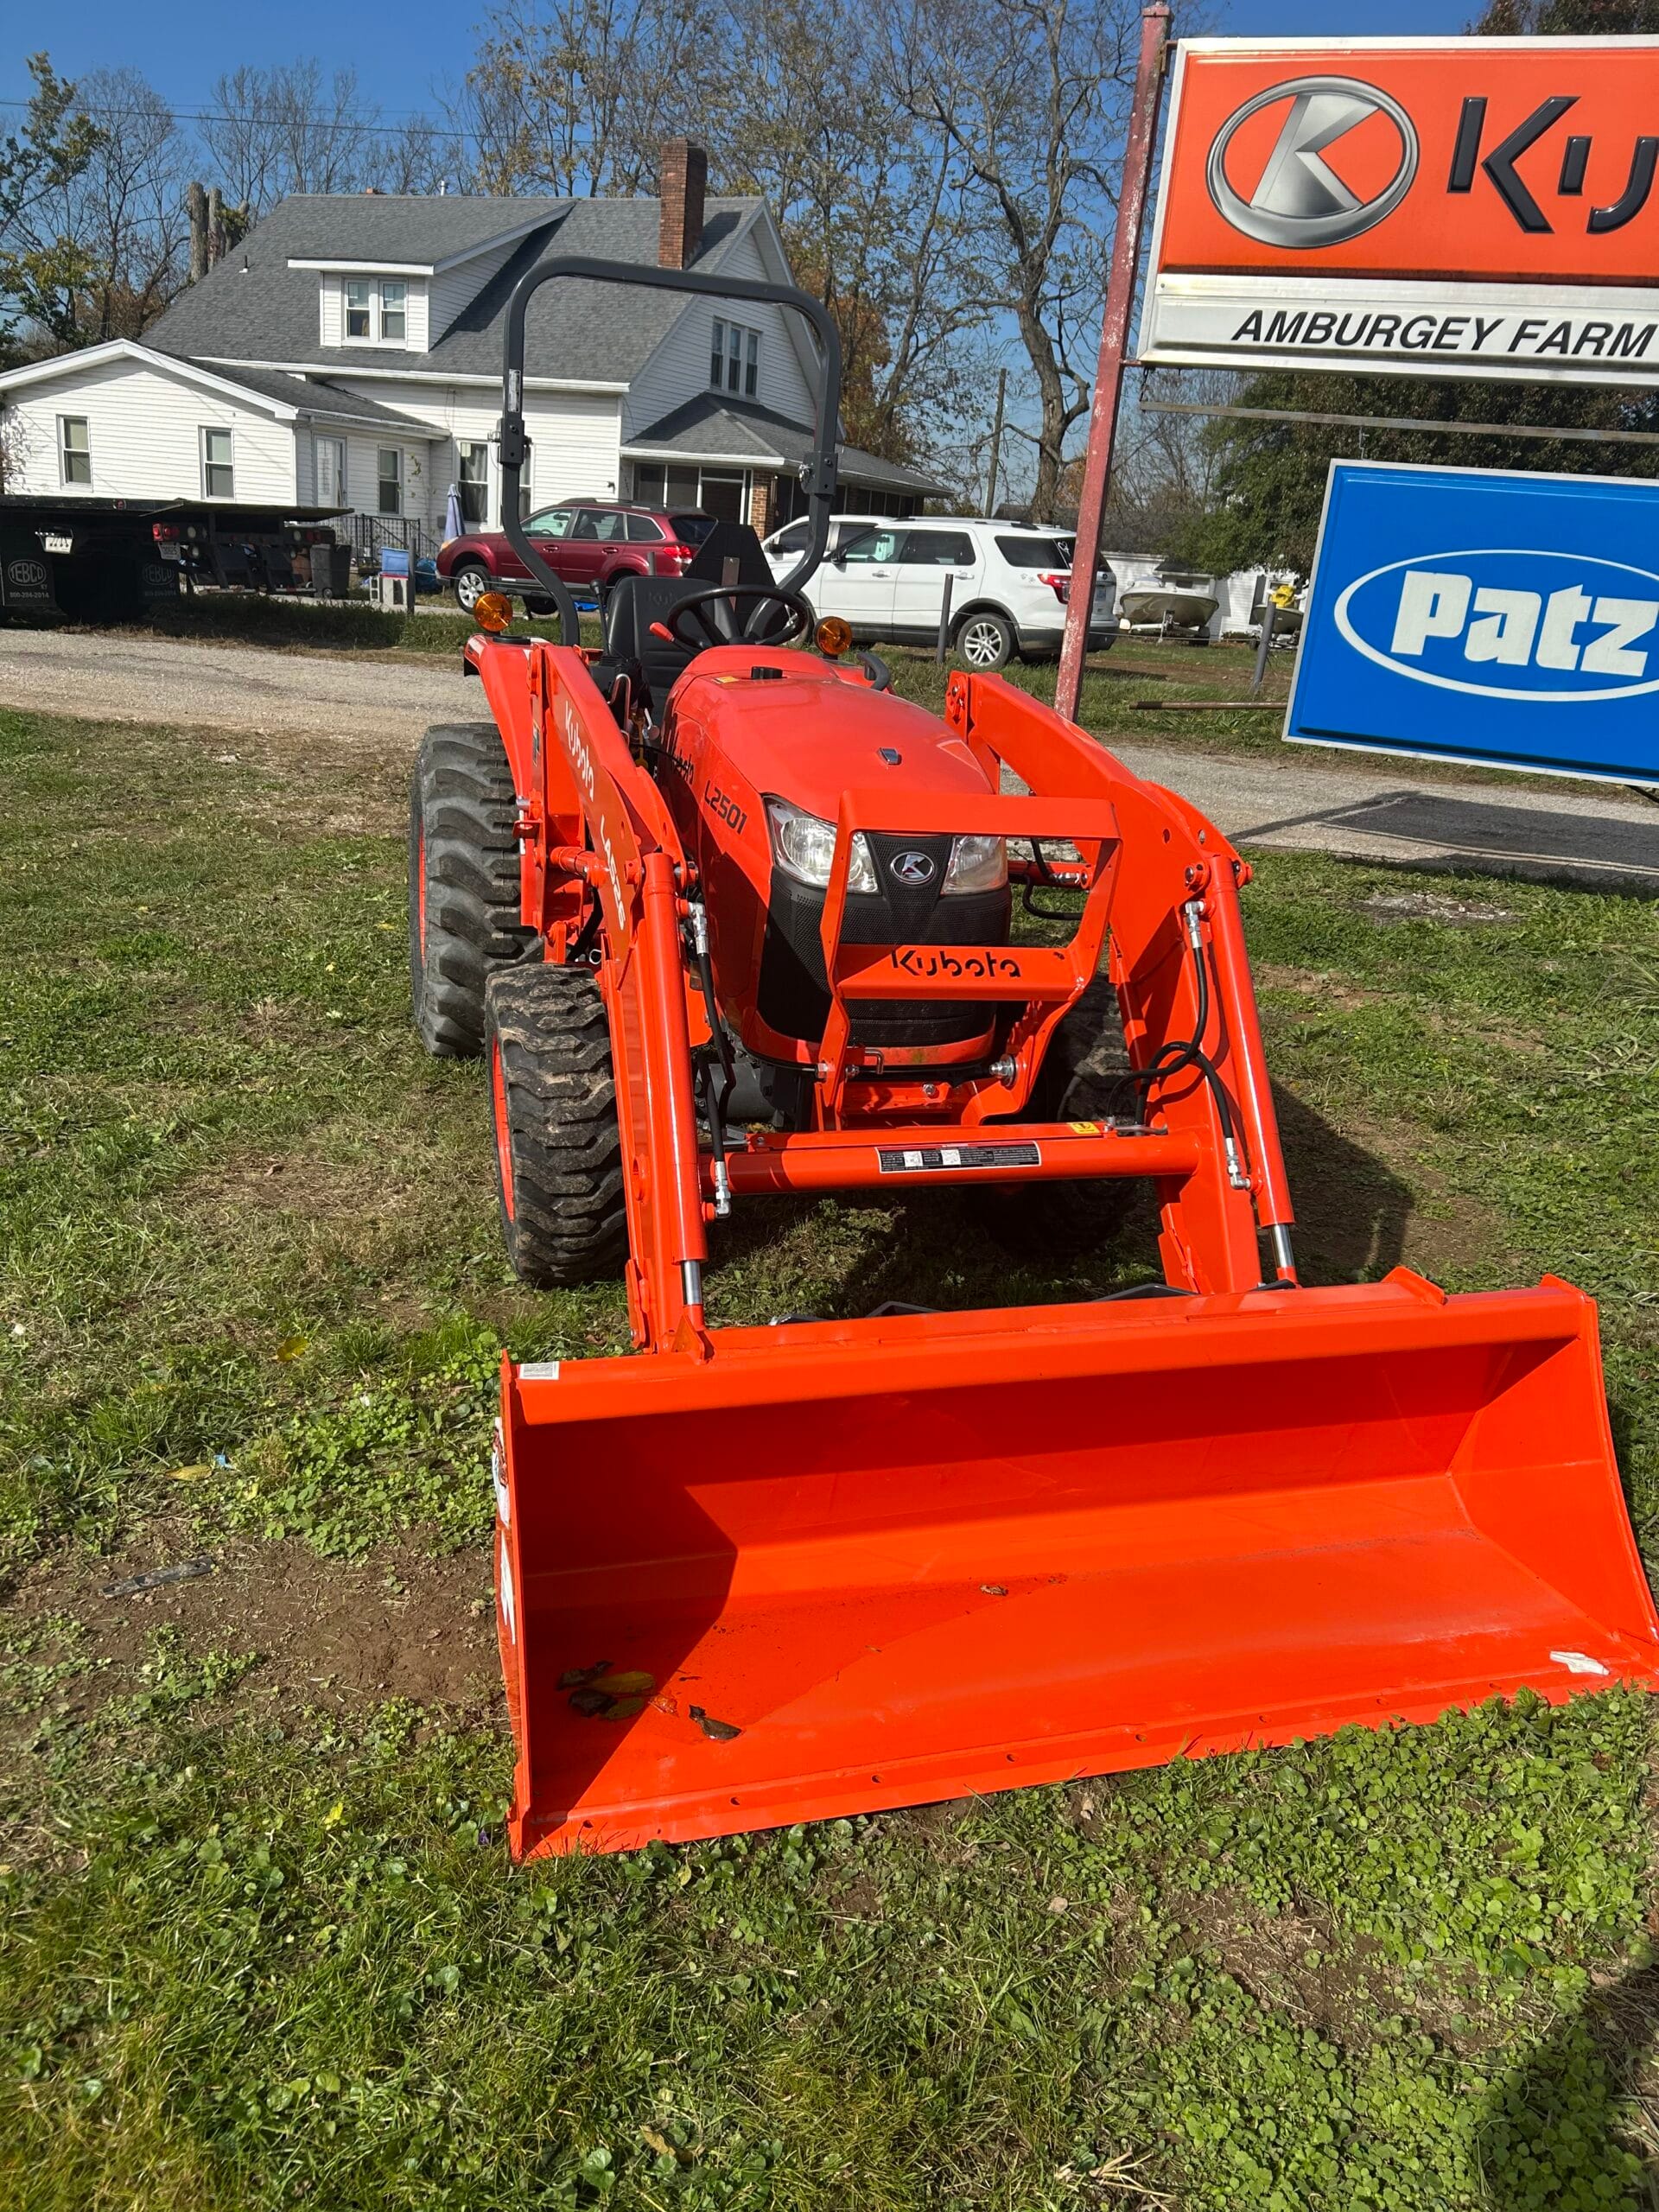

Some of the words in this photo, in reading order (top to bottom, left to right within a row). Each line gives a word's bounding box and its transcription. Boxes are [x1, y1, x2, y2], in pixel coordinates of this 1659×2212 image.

[1230, 309, 1503, 352] AMBURGEY
[1507, 318, 1657, 358] FARM
[10, 562, 44, 583] TEBCO
[1390, 569, 1659, 677] Patz
[564, 699, 595, 803] Kubota
[703, 779, 748, 836] L2501
[891, 950, 1021, 978] Kubota
